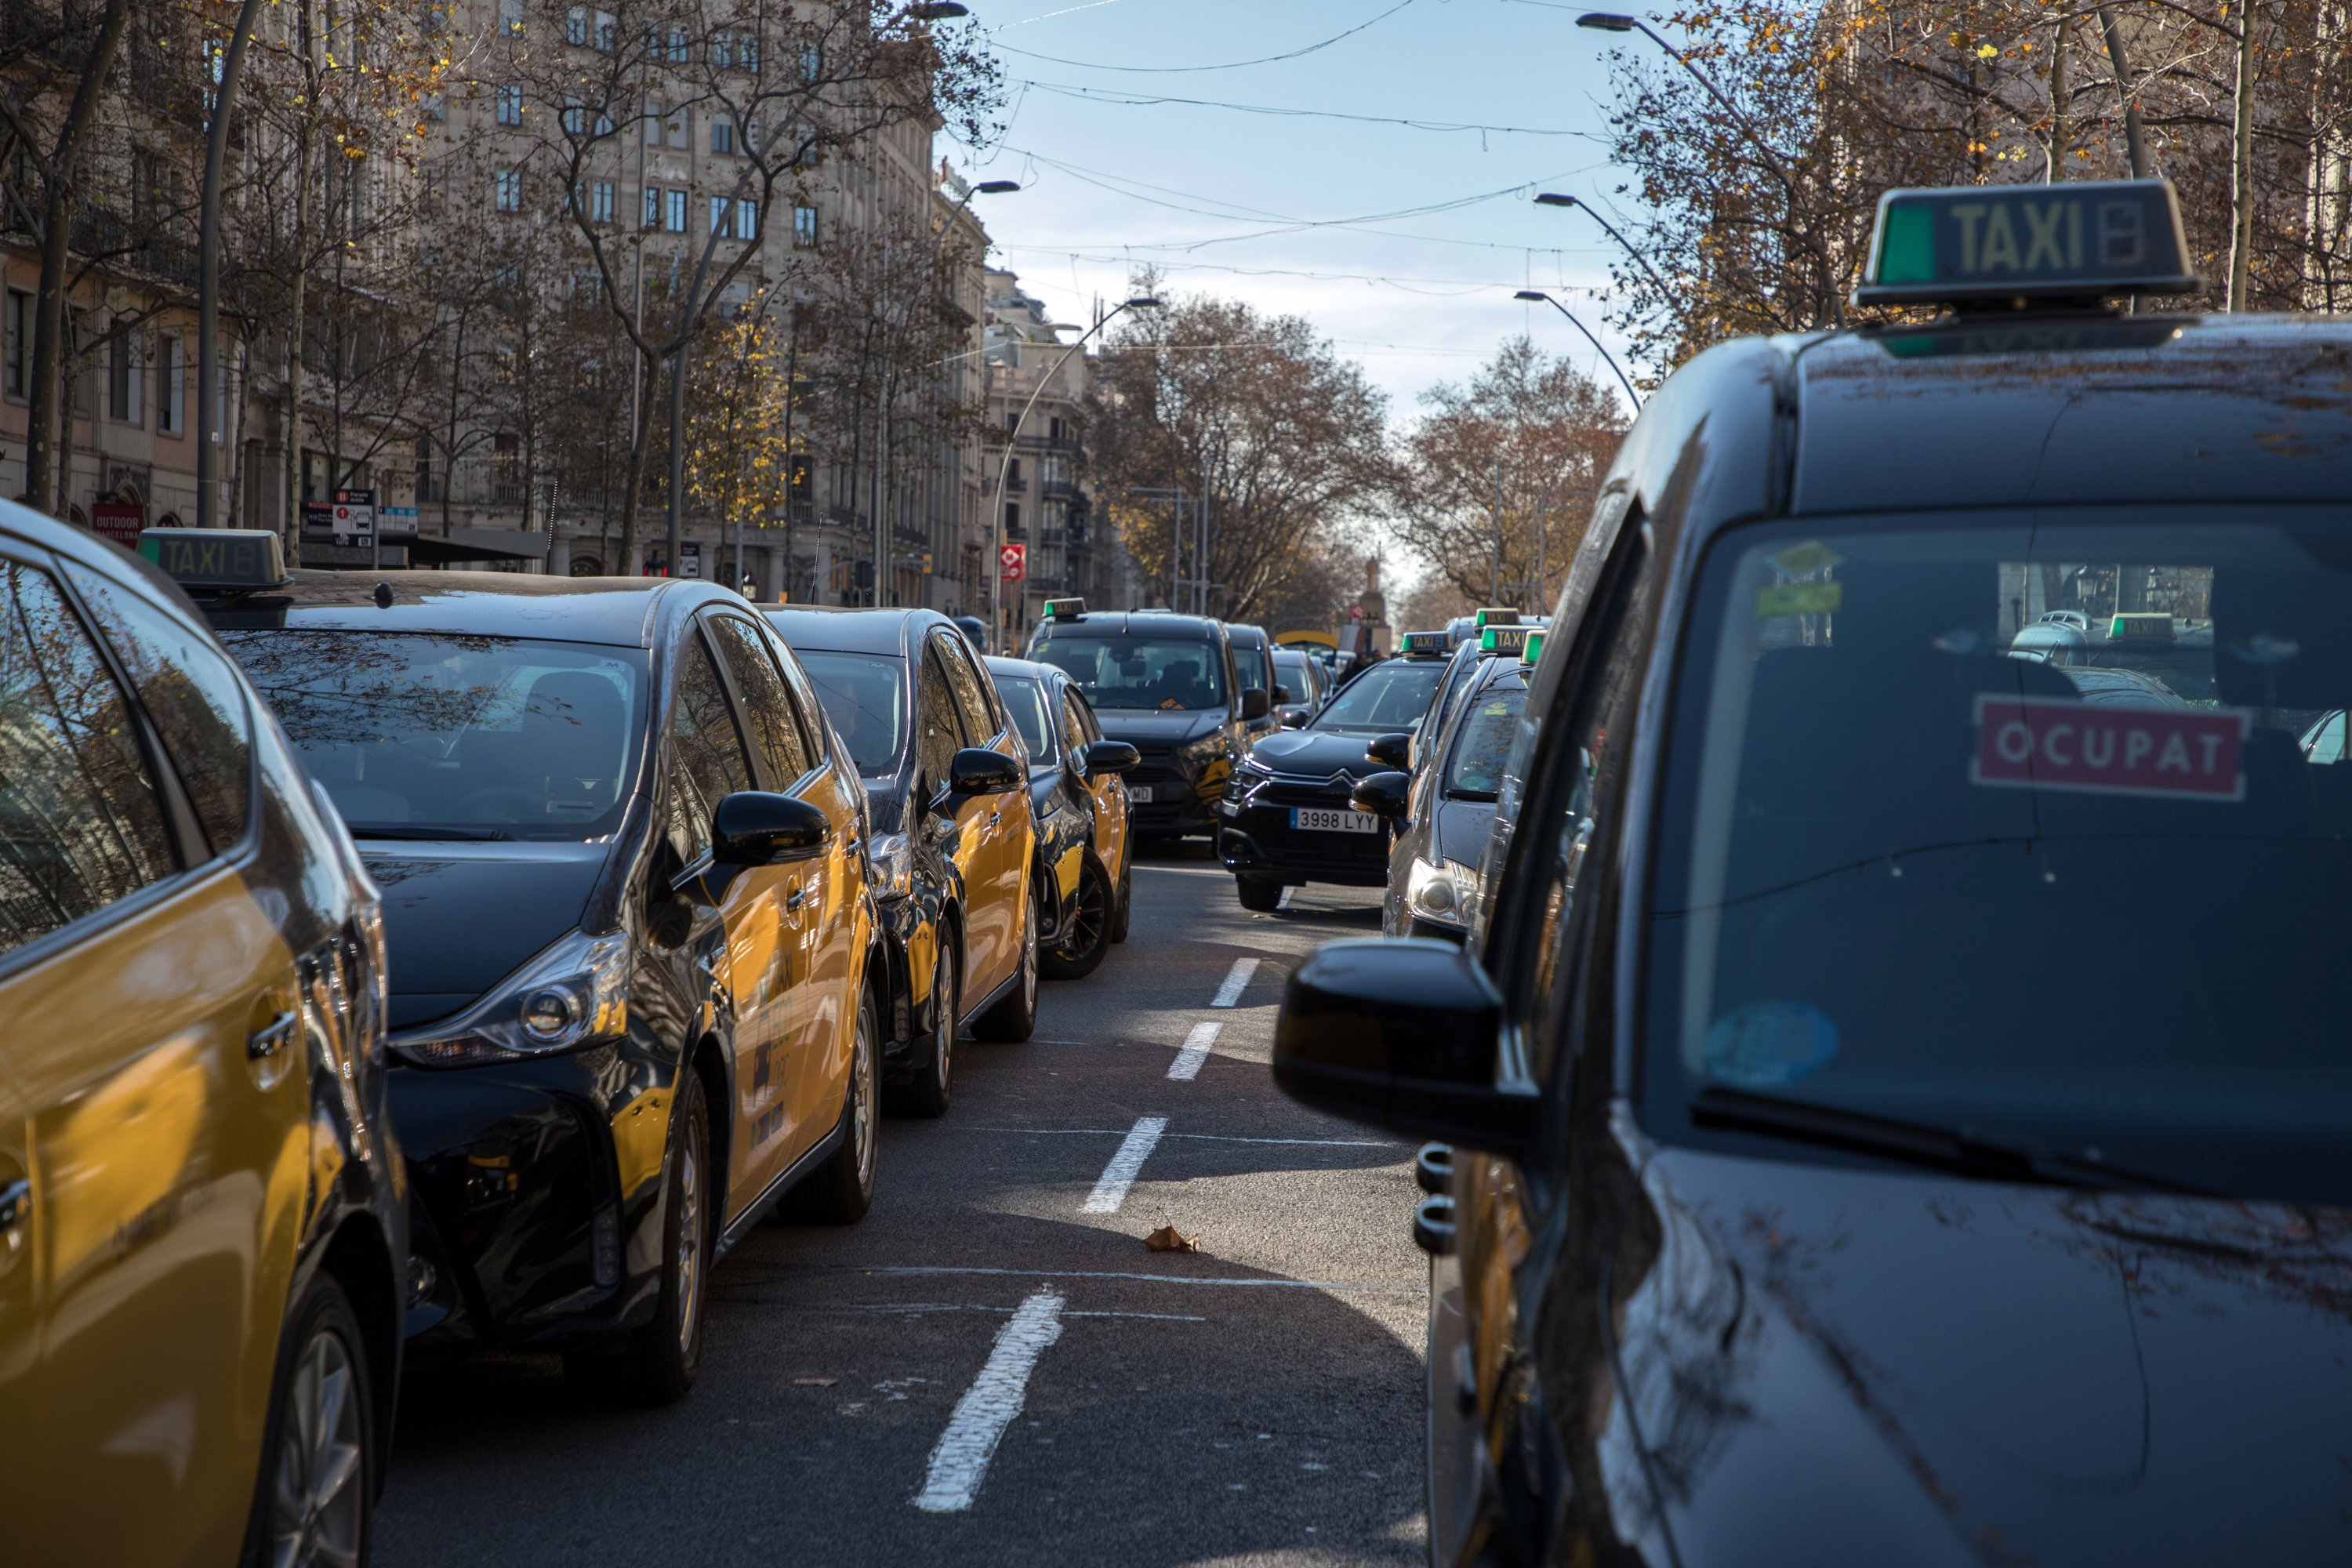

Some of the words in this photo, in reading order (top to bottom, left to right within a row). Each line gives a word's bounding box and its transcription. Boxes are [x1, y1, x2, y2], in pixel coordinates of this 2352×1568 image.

[1950, 201, 2084, 272] TAXI
[96, 516, 139, 528] OUTDOOR
[98, 529, 139, 539] ARCELONA
[165, 539, 226, 575] TAXI
[1054, 602, 1072, 612] TAXI
[1486, 612, 1505, 623] TAXI
[2126, 620, 2154, 634] TAXI
[1413, 636, 1433, 648] TAXI
[1497, 631, 1525, 647] TAXI
[1996, 720, 2225, 775] OCUPAT
[1133, 788, 1149, 800] MD
[1301, 811, 1339, 828] 3998
[1345, 814, 1374, 830] LYY
